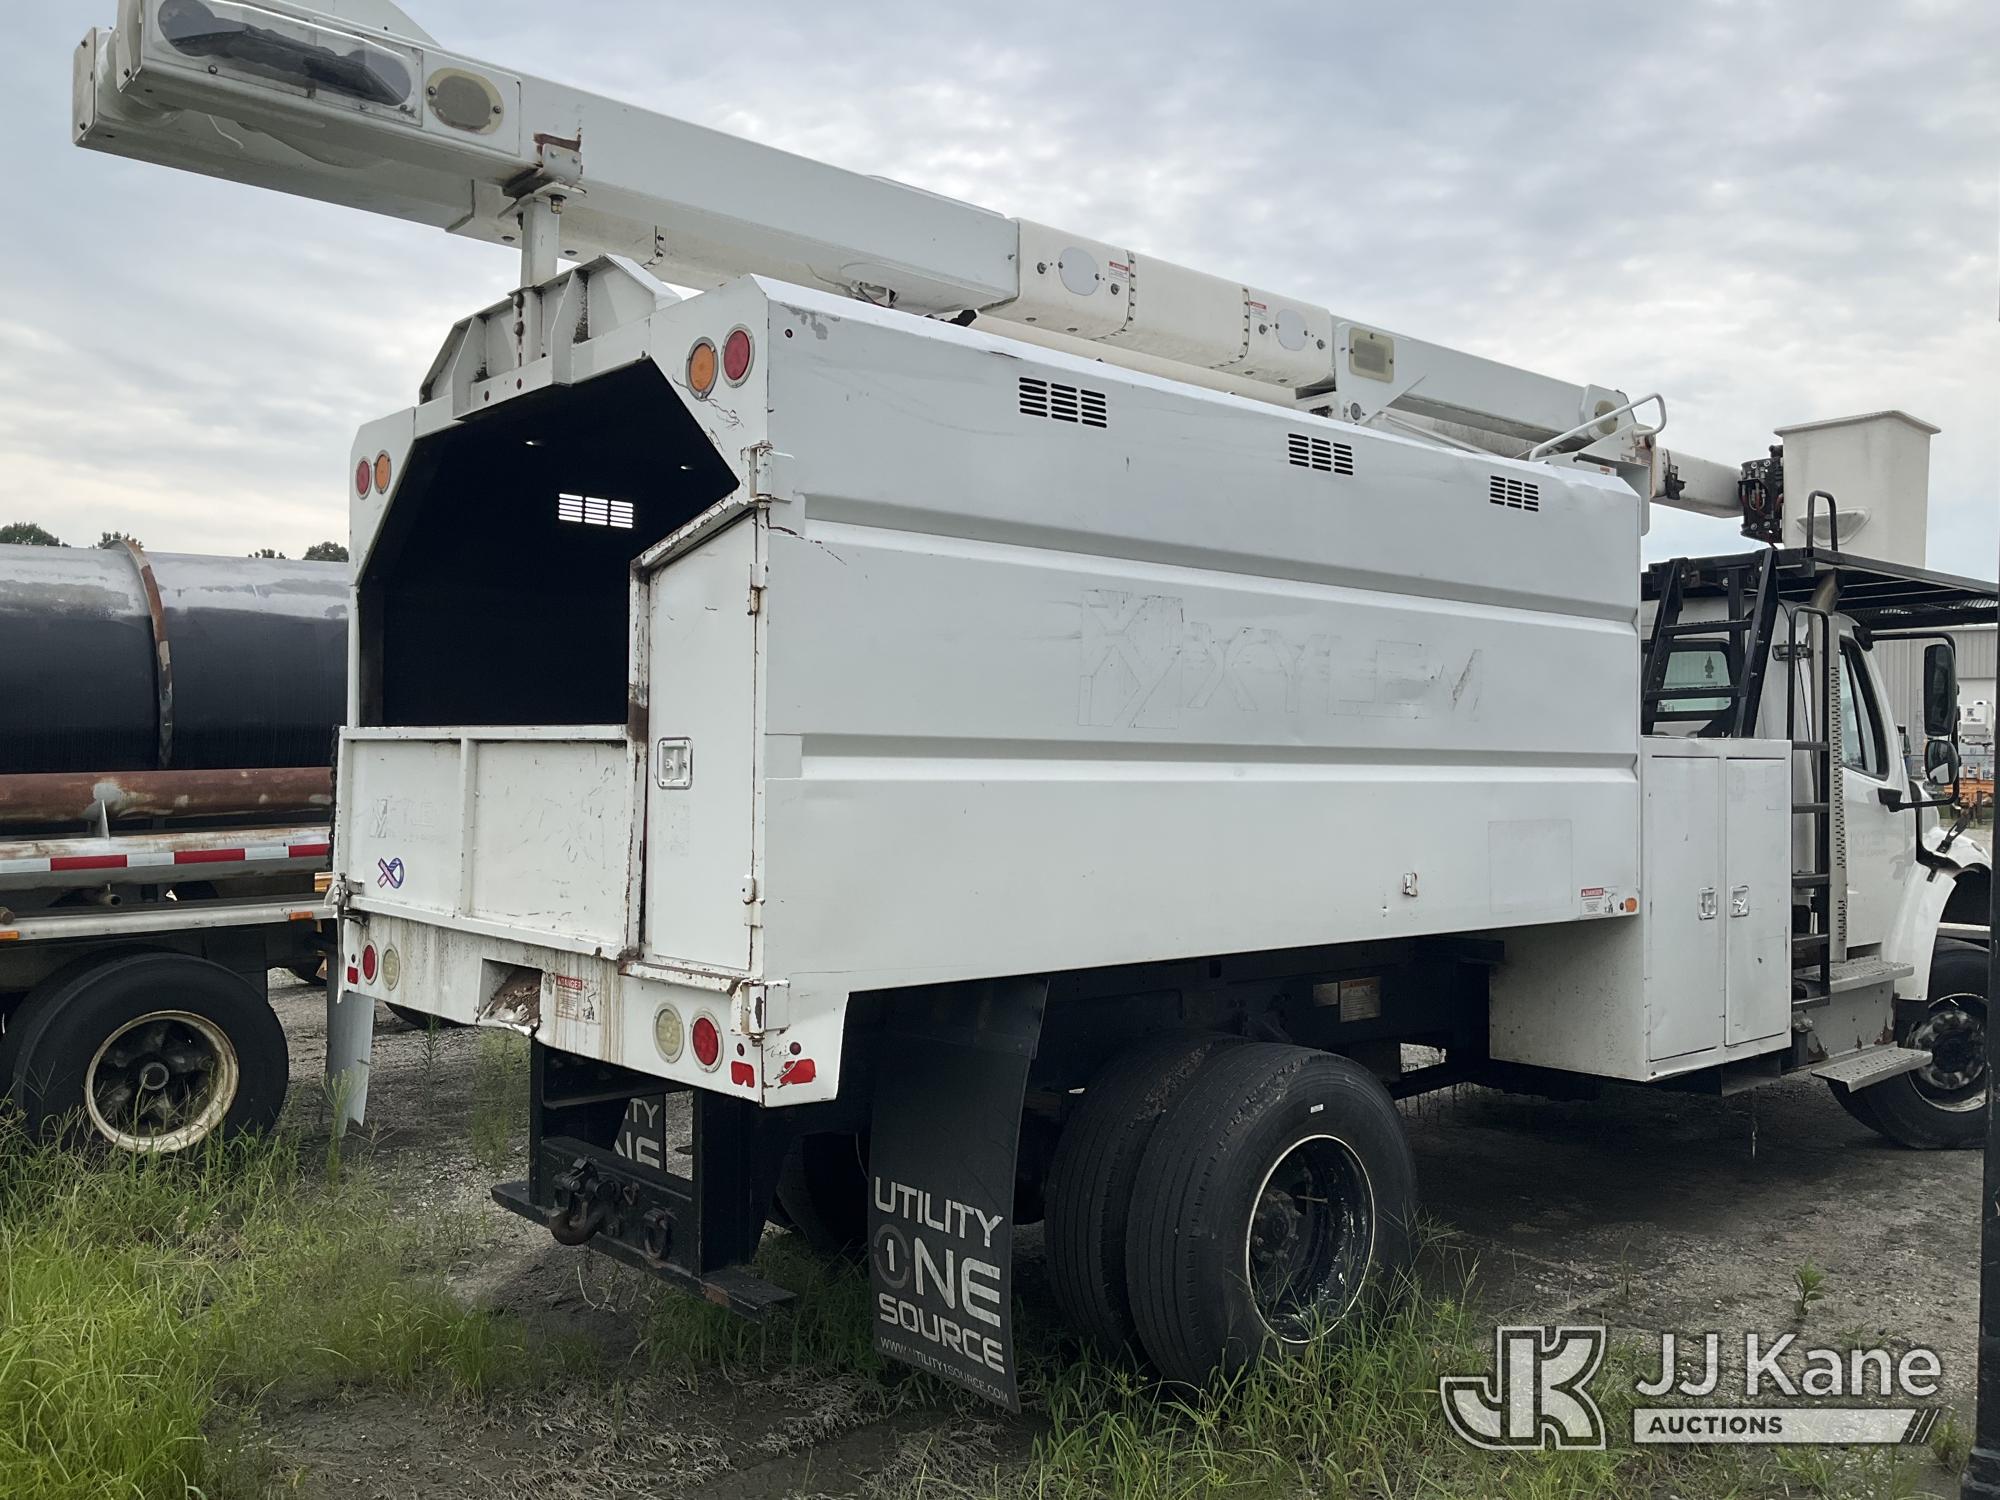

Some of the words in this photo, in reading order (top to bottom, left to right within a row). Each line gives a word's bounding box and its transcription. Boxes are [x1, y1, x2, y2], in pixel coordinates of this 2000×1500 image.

[625, 1098, 660, 1128] TY
[875, 1176, 1003, 1247] UTILITY
[878, 1292, 1005, 1374] SOURCE
